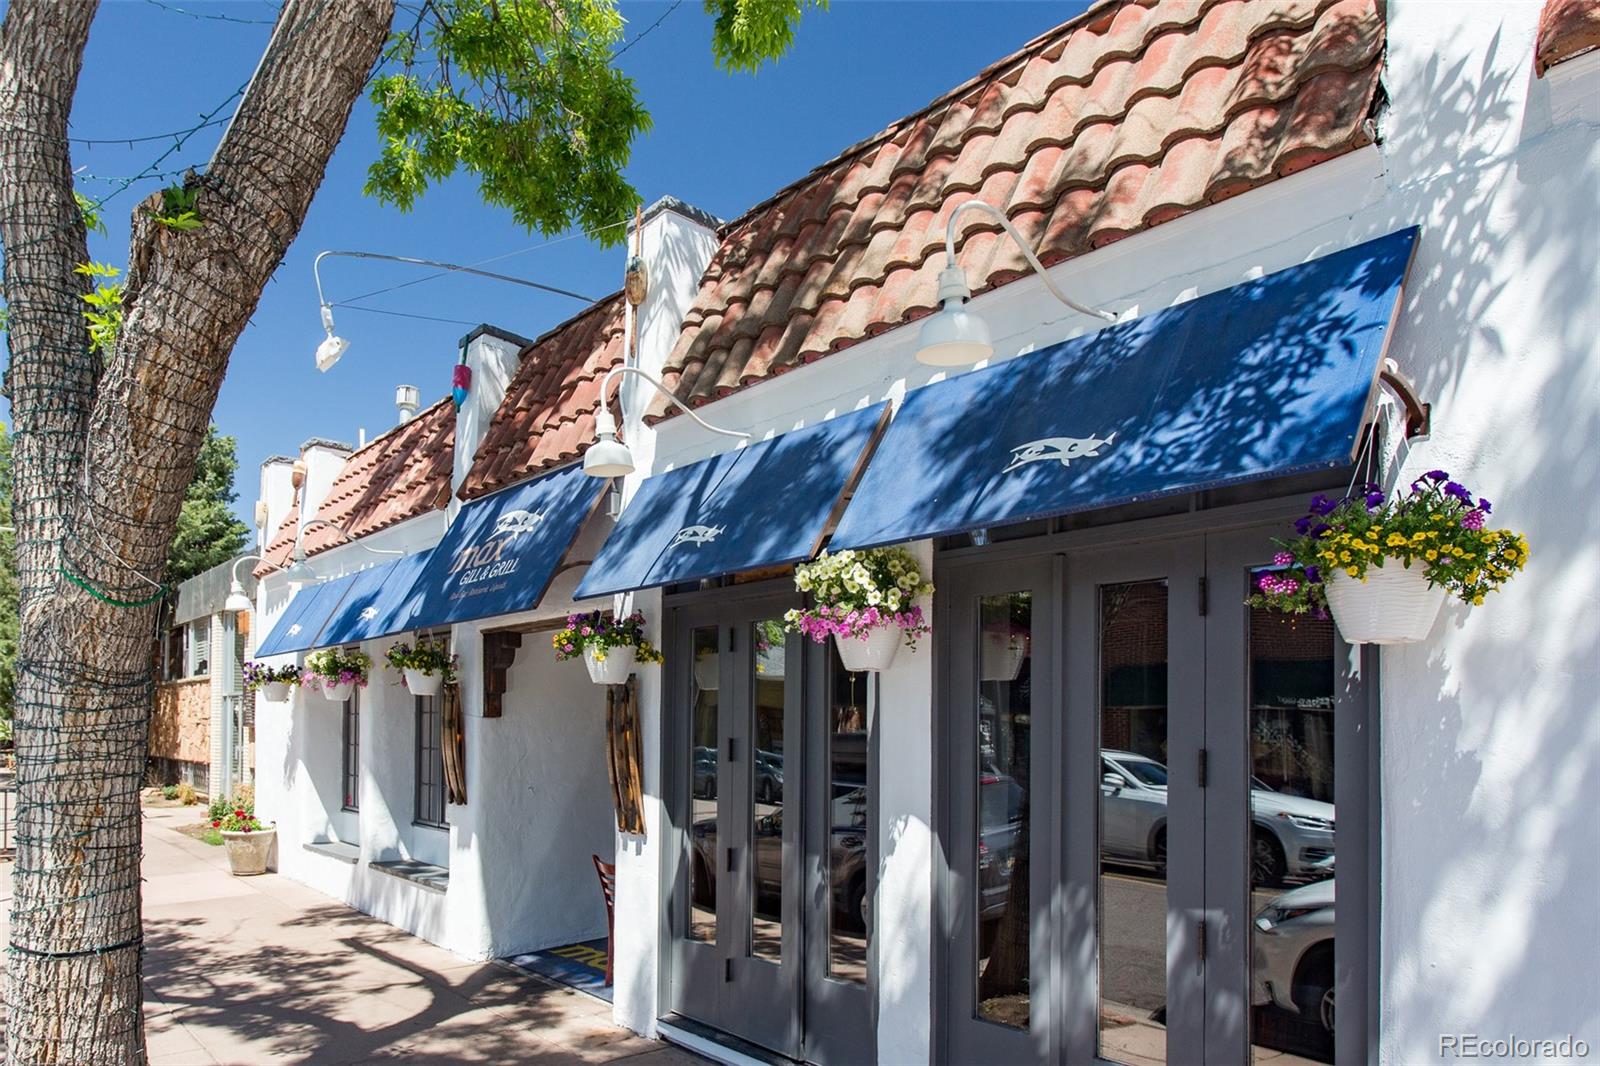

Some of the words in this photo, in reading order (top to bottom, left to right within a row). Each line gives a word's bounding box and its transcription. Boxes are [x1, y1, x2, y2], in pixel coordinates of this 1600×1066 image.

[459, 568, 481, 585] GILL
[479, 565, 490, 580] &
[488, 557, 520, 578] GRILL
